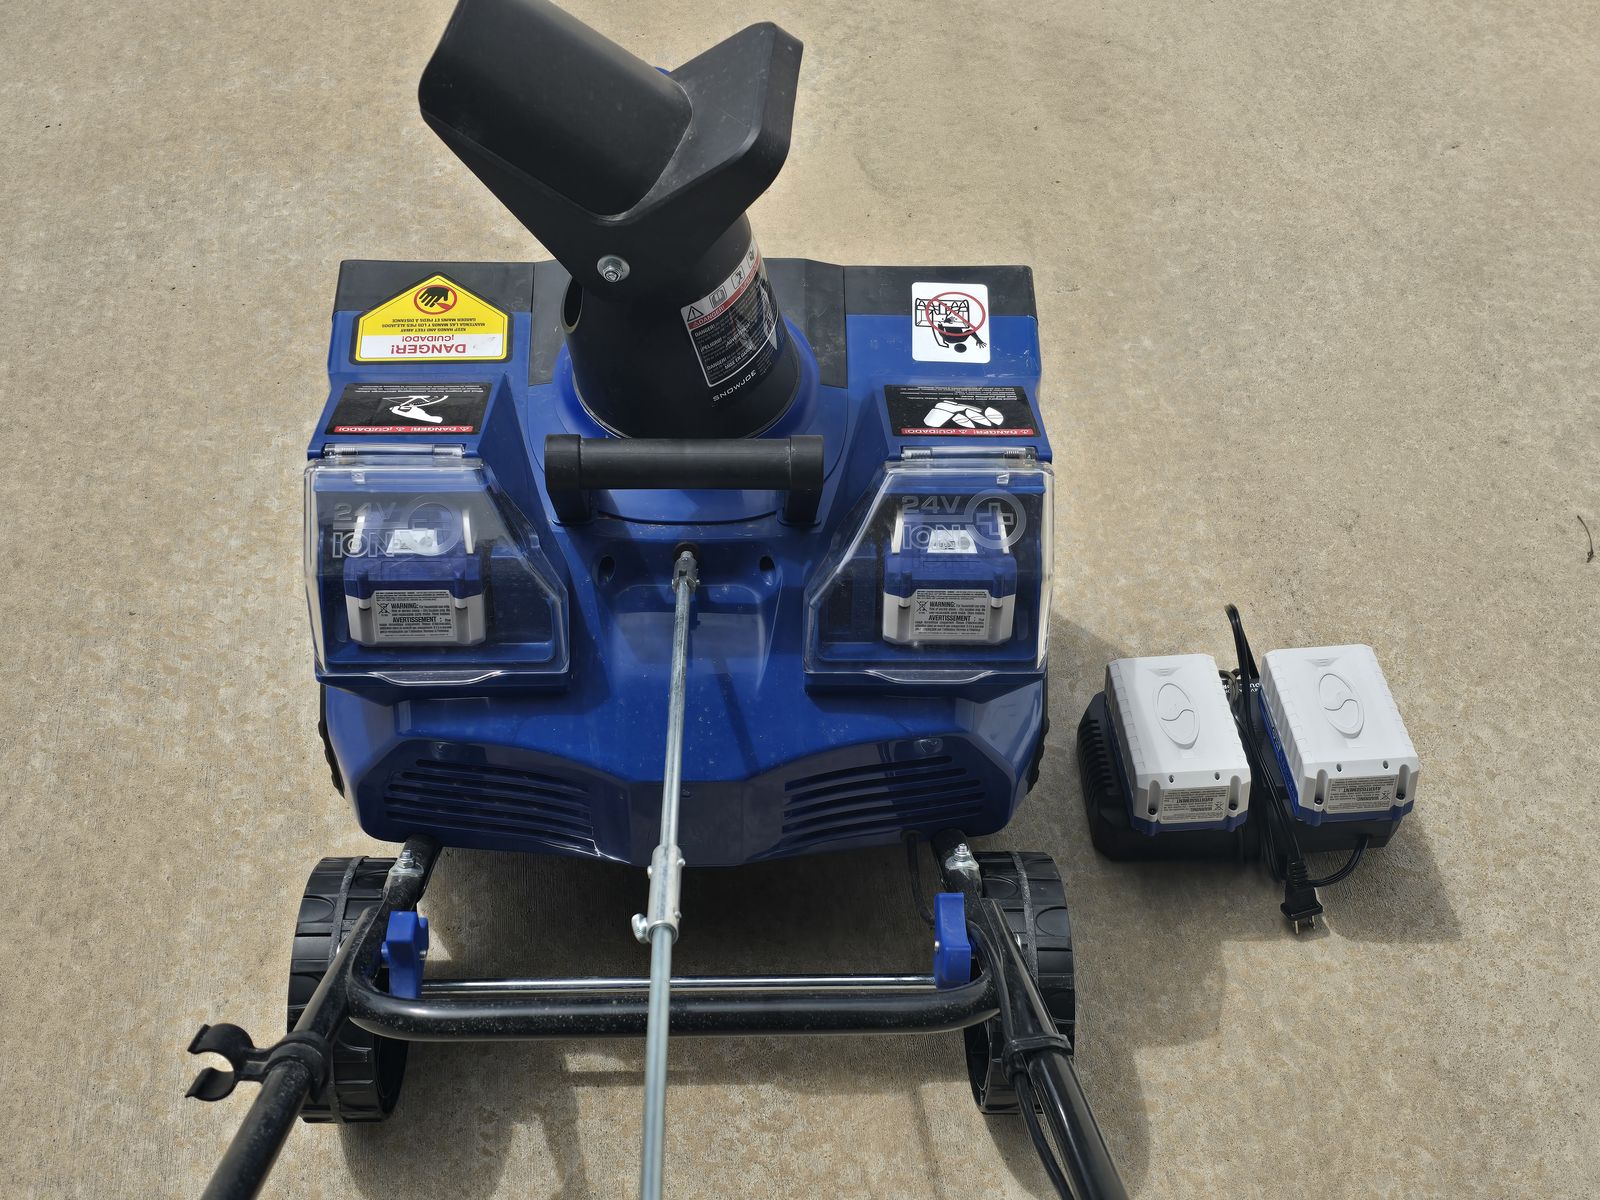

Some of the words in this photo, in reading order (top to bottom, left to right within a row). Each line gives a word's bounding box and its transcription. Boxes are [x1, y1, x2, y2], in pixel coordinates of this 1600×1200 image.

[698, 305, 725, 324] DANGER!
[401, 334, 454, 342] ¡CUIDADO!
[390, 343, 467, 354] DANGER!
[902, 495, 960, 514] 24V
